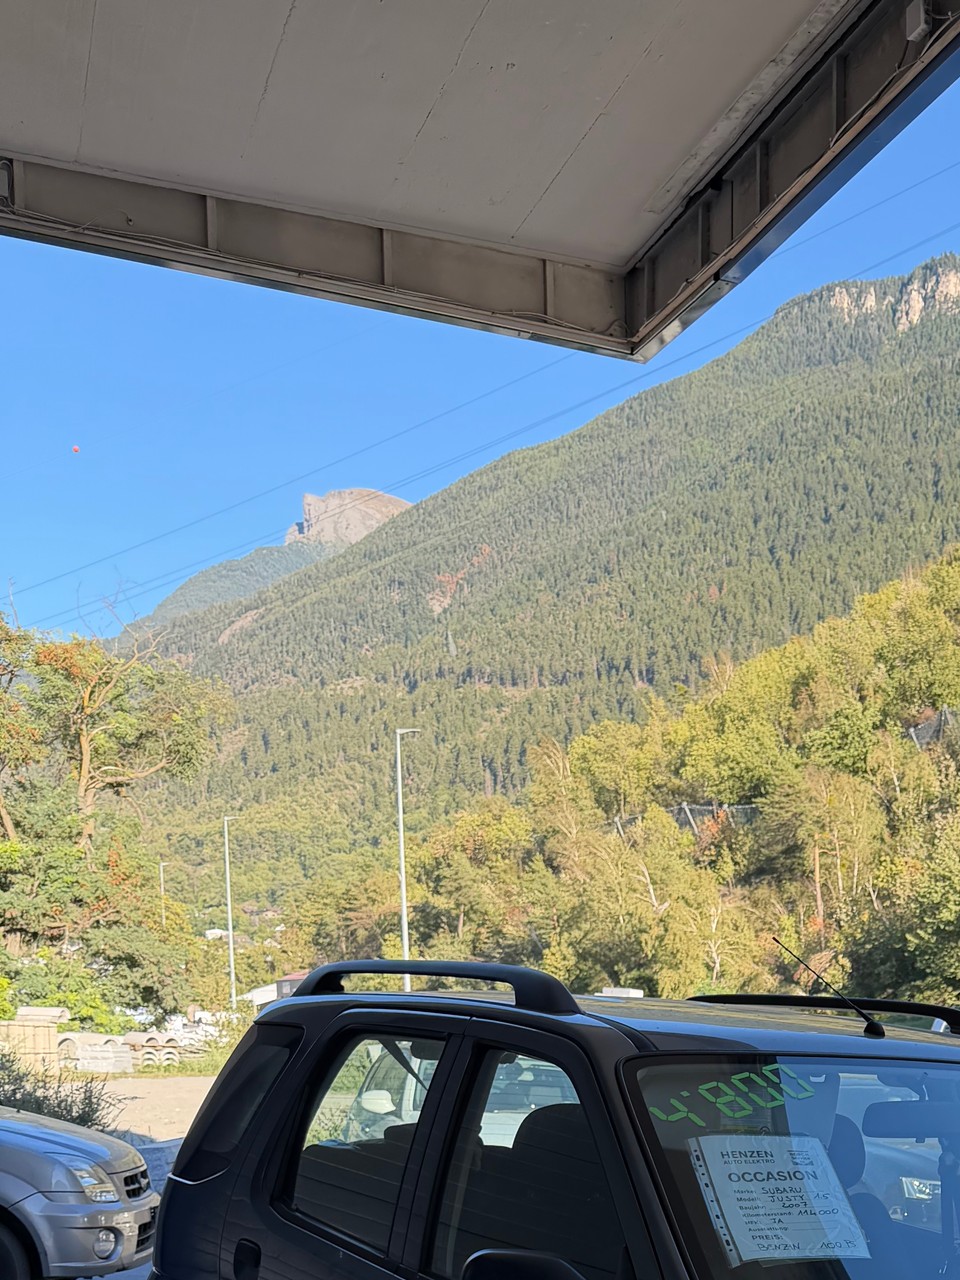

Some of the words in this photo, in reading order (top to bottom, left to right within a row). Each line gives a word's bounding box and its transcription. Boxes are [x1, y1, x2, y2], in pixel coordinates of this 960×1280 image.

[720, 1150, 774, 1159] HENZEN
[728, 1170, 819, 1183] OCCASION
[761, 1186, 802, 1195] SUBARU
[768, 1194, 805, 1203] JUSTY
[782, 1201, 809, 1209] 2007
